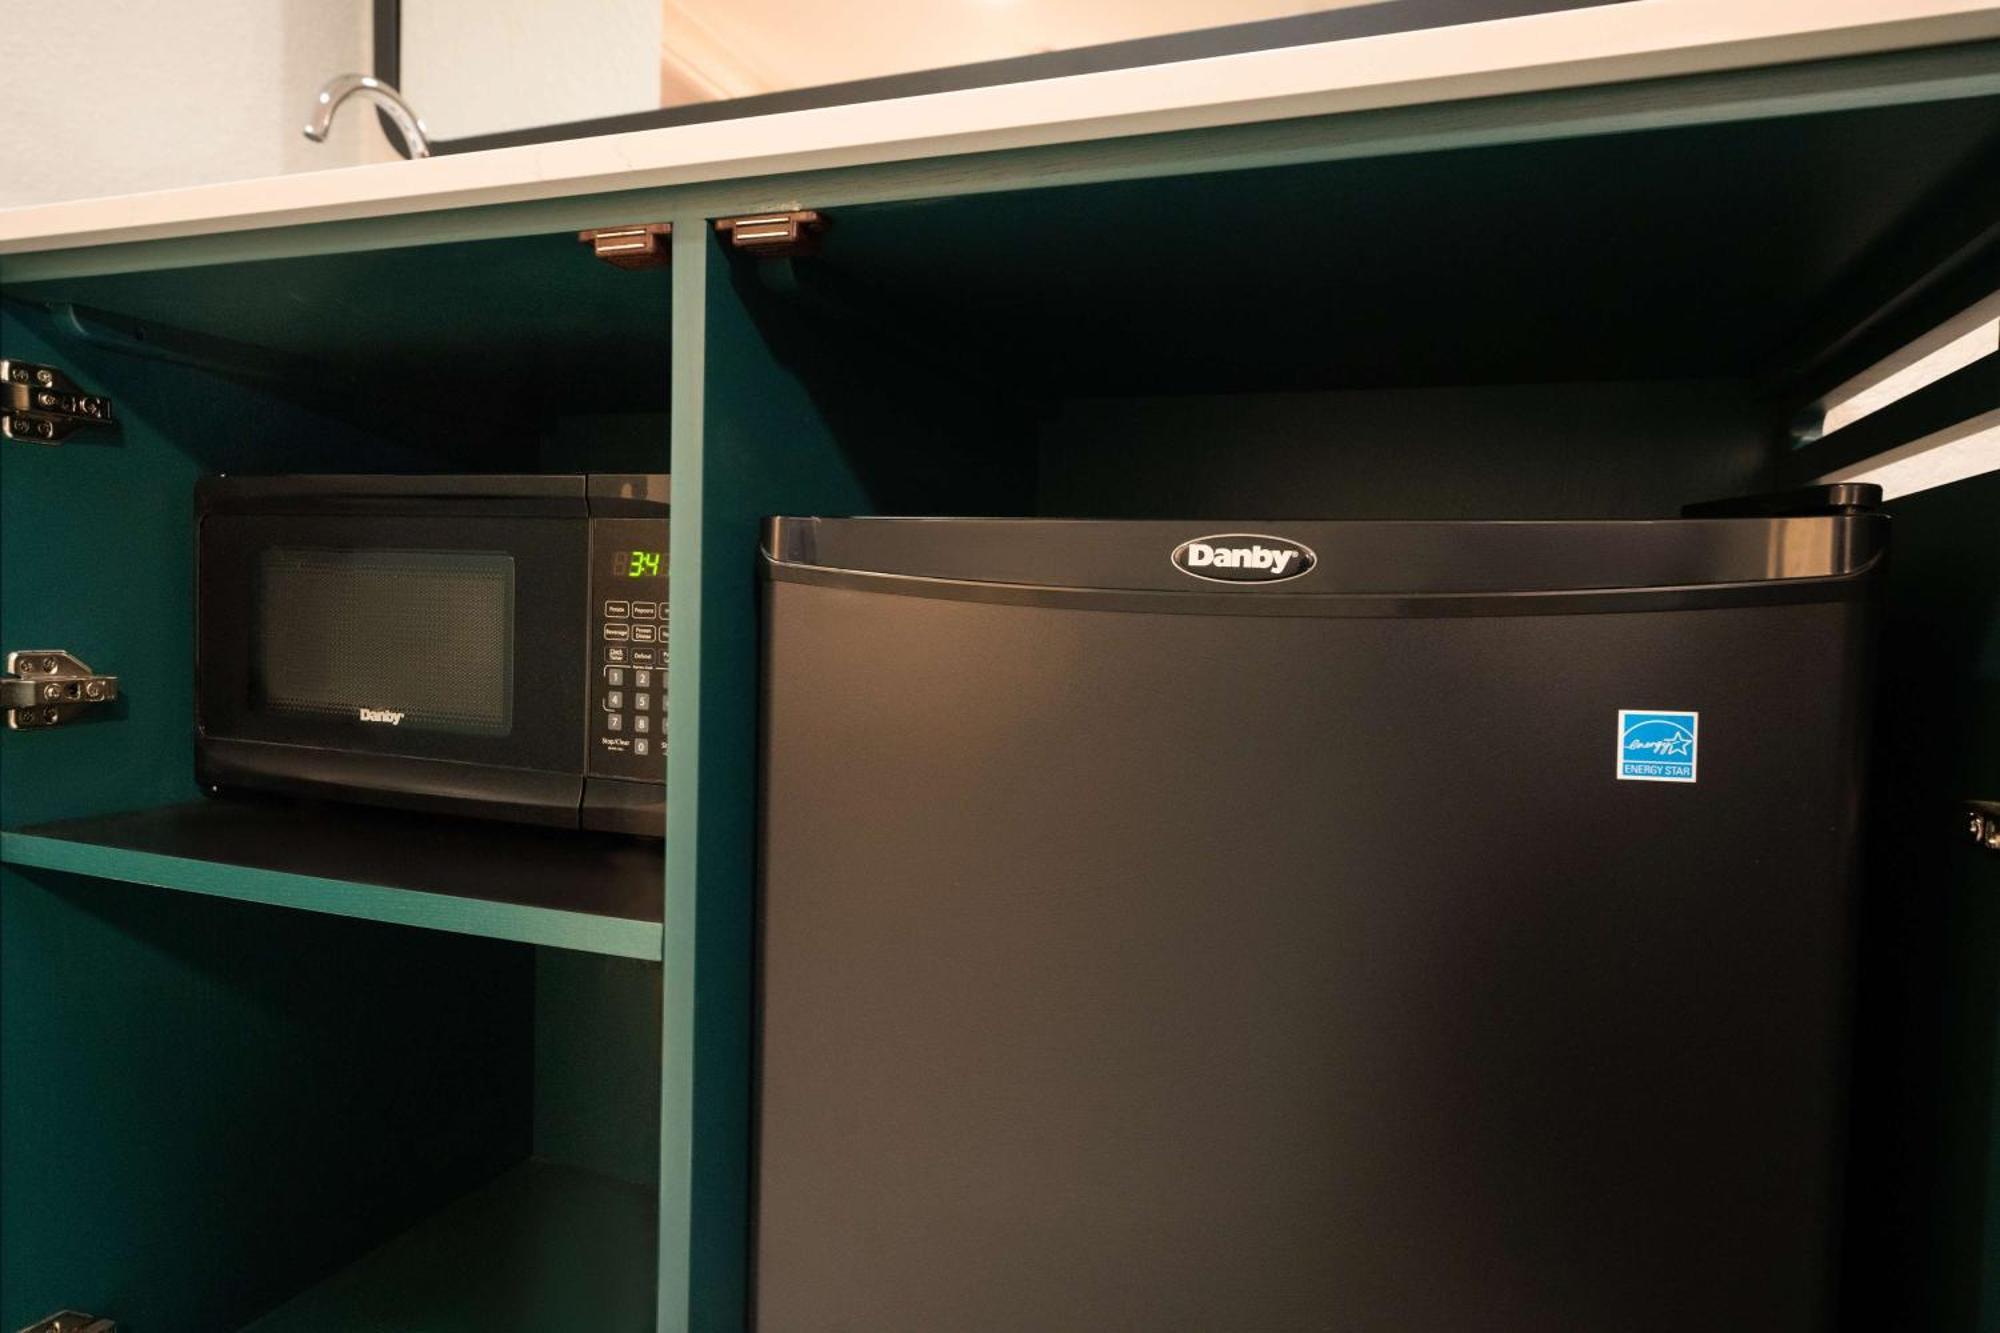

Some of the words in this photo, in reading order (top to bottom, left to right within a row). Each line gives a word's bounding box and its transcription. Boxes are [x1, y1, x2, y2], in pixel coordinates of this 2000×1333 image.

[1188, 543, 1294, 574] Danby
[360, 708, 401, 725] Danby
[638, 742, 645, 752] 0
[1624, 764, 1664, 775] ENERGY
[1665, 765, 1691, 776] STAR
